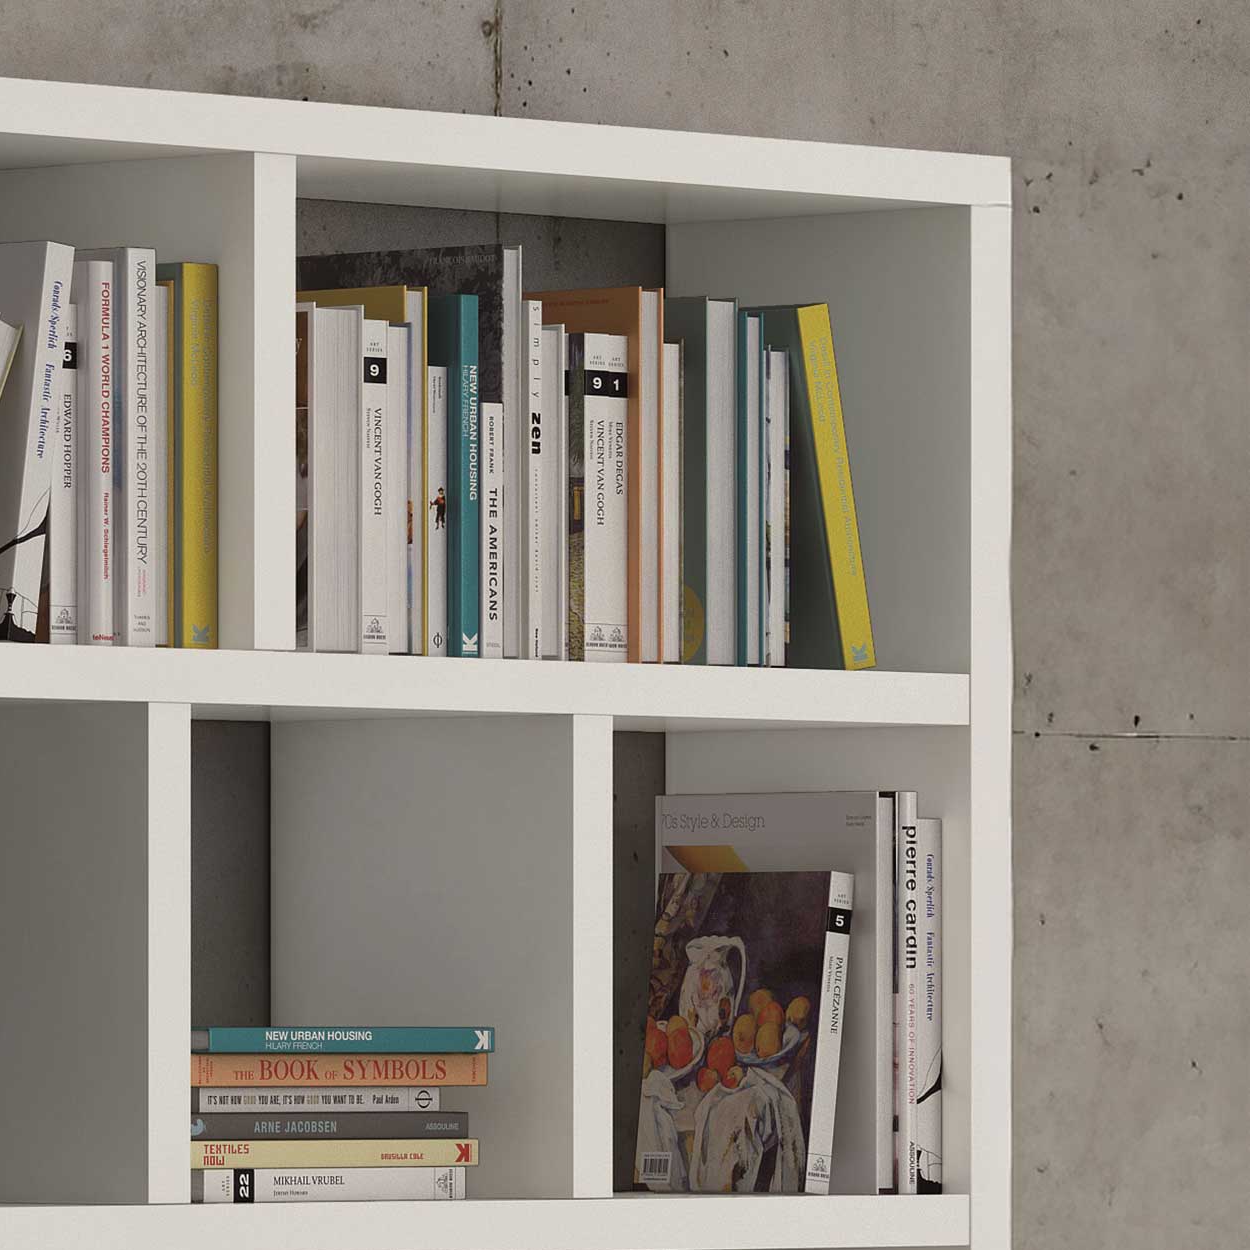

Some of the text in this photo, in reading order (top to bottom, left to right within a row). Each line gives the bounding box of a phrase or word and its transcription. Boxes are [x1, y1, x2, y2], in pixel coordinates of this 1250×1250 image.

[136, 260, 147, 320] VISIONARY
[136, 321, 147, 413] ARCHITECTURE
[370, 364, 380, 377] 9
[42, 363, 55, 402] Fantastic
[613, 379, 620, 391] 1
[136, 415, 147, 432] OF
[36, 406, 50, 459] Architecture
[469, 365, 477, 501] NEW URBAN HOUSING
[136, 433, 147, 460] THE
[373, 407, 383, 516] VINCENT VAN GOGH
[615, 421, 624, 495] EDGAR DEGAS
[136, 462, 147, 499] 20TH
[136, 499, 147, 565] CENTURY
[902, 825, 918, 969] pierre cardin
[909, 983, 915, 995] 60
[265, 1031, 373, 1041] NEW URBAN HOUSING
[909, 1031, 915, 1045] OF
[265, 1041, 323, 1050] HILARY FRENCH
[234, 1059, 447, 1080] THE BOOK OF SYMBOLS
[219, 1095, 229, 1105] NOT
[230, 1095, 242, 1105] HOW
[258, 1095, 268, 1105] YOU
[293, 1095, 305, 1105] HOW
[321, 1095, 332, 1105] YOU
[333, 1095, 347, 1105] WANT
[348, 1095, 355, 1105] TO
[372, 1094, 399, 1105] Paul Arden
[254, 1121, 337, 1133] ARNE JACOBSEN
[425, 1123, 460, 1131] ASSOULINE
[203, 1144, 250, 1155] TEXTILES
[203, 1156, 225, 1166] NOW
[238, 1174, 250, 1199] 22
[273, 1175, 345, 1186] MIKHAIL VRUBEL
